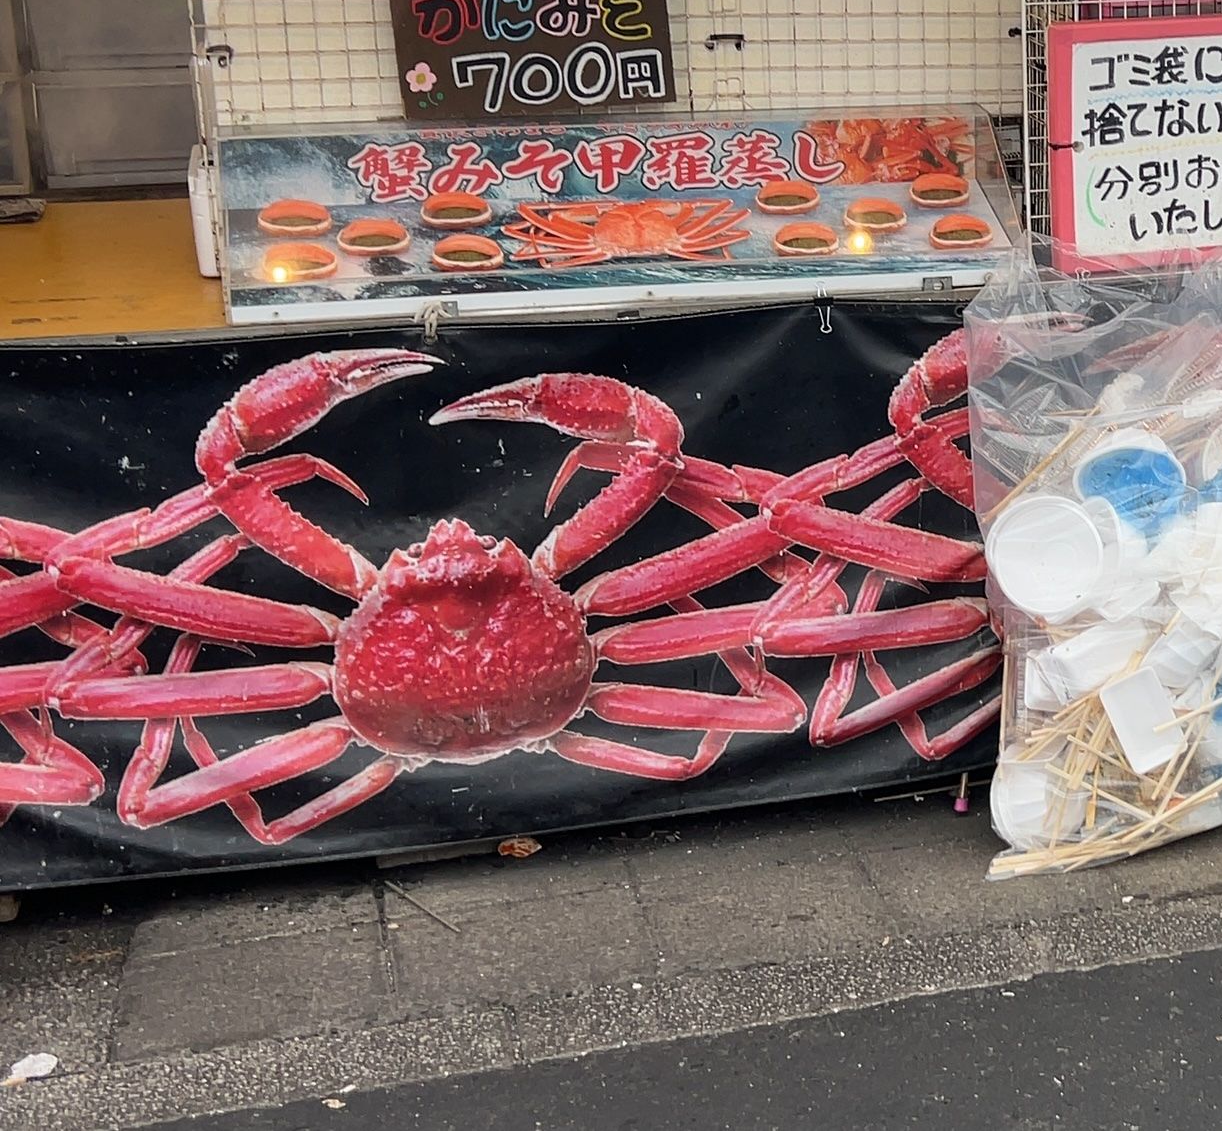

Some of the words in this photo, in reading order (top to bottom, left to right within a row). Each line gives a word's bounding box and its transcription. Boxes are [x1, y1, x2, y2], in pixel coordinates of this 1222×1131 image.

[452, 41, 665, 113] 700円
[347, 129, 847, 203] 蟹みそ甲羅蒸し
